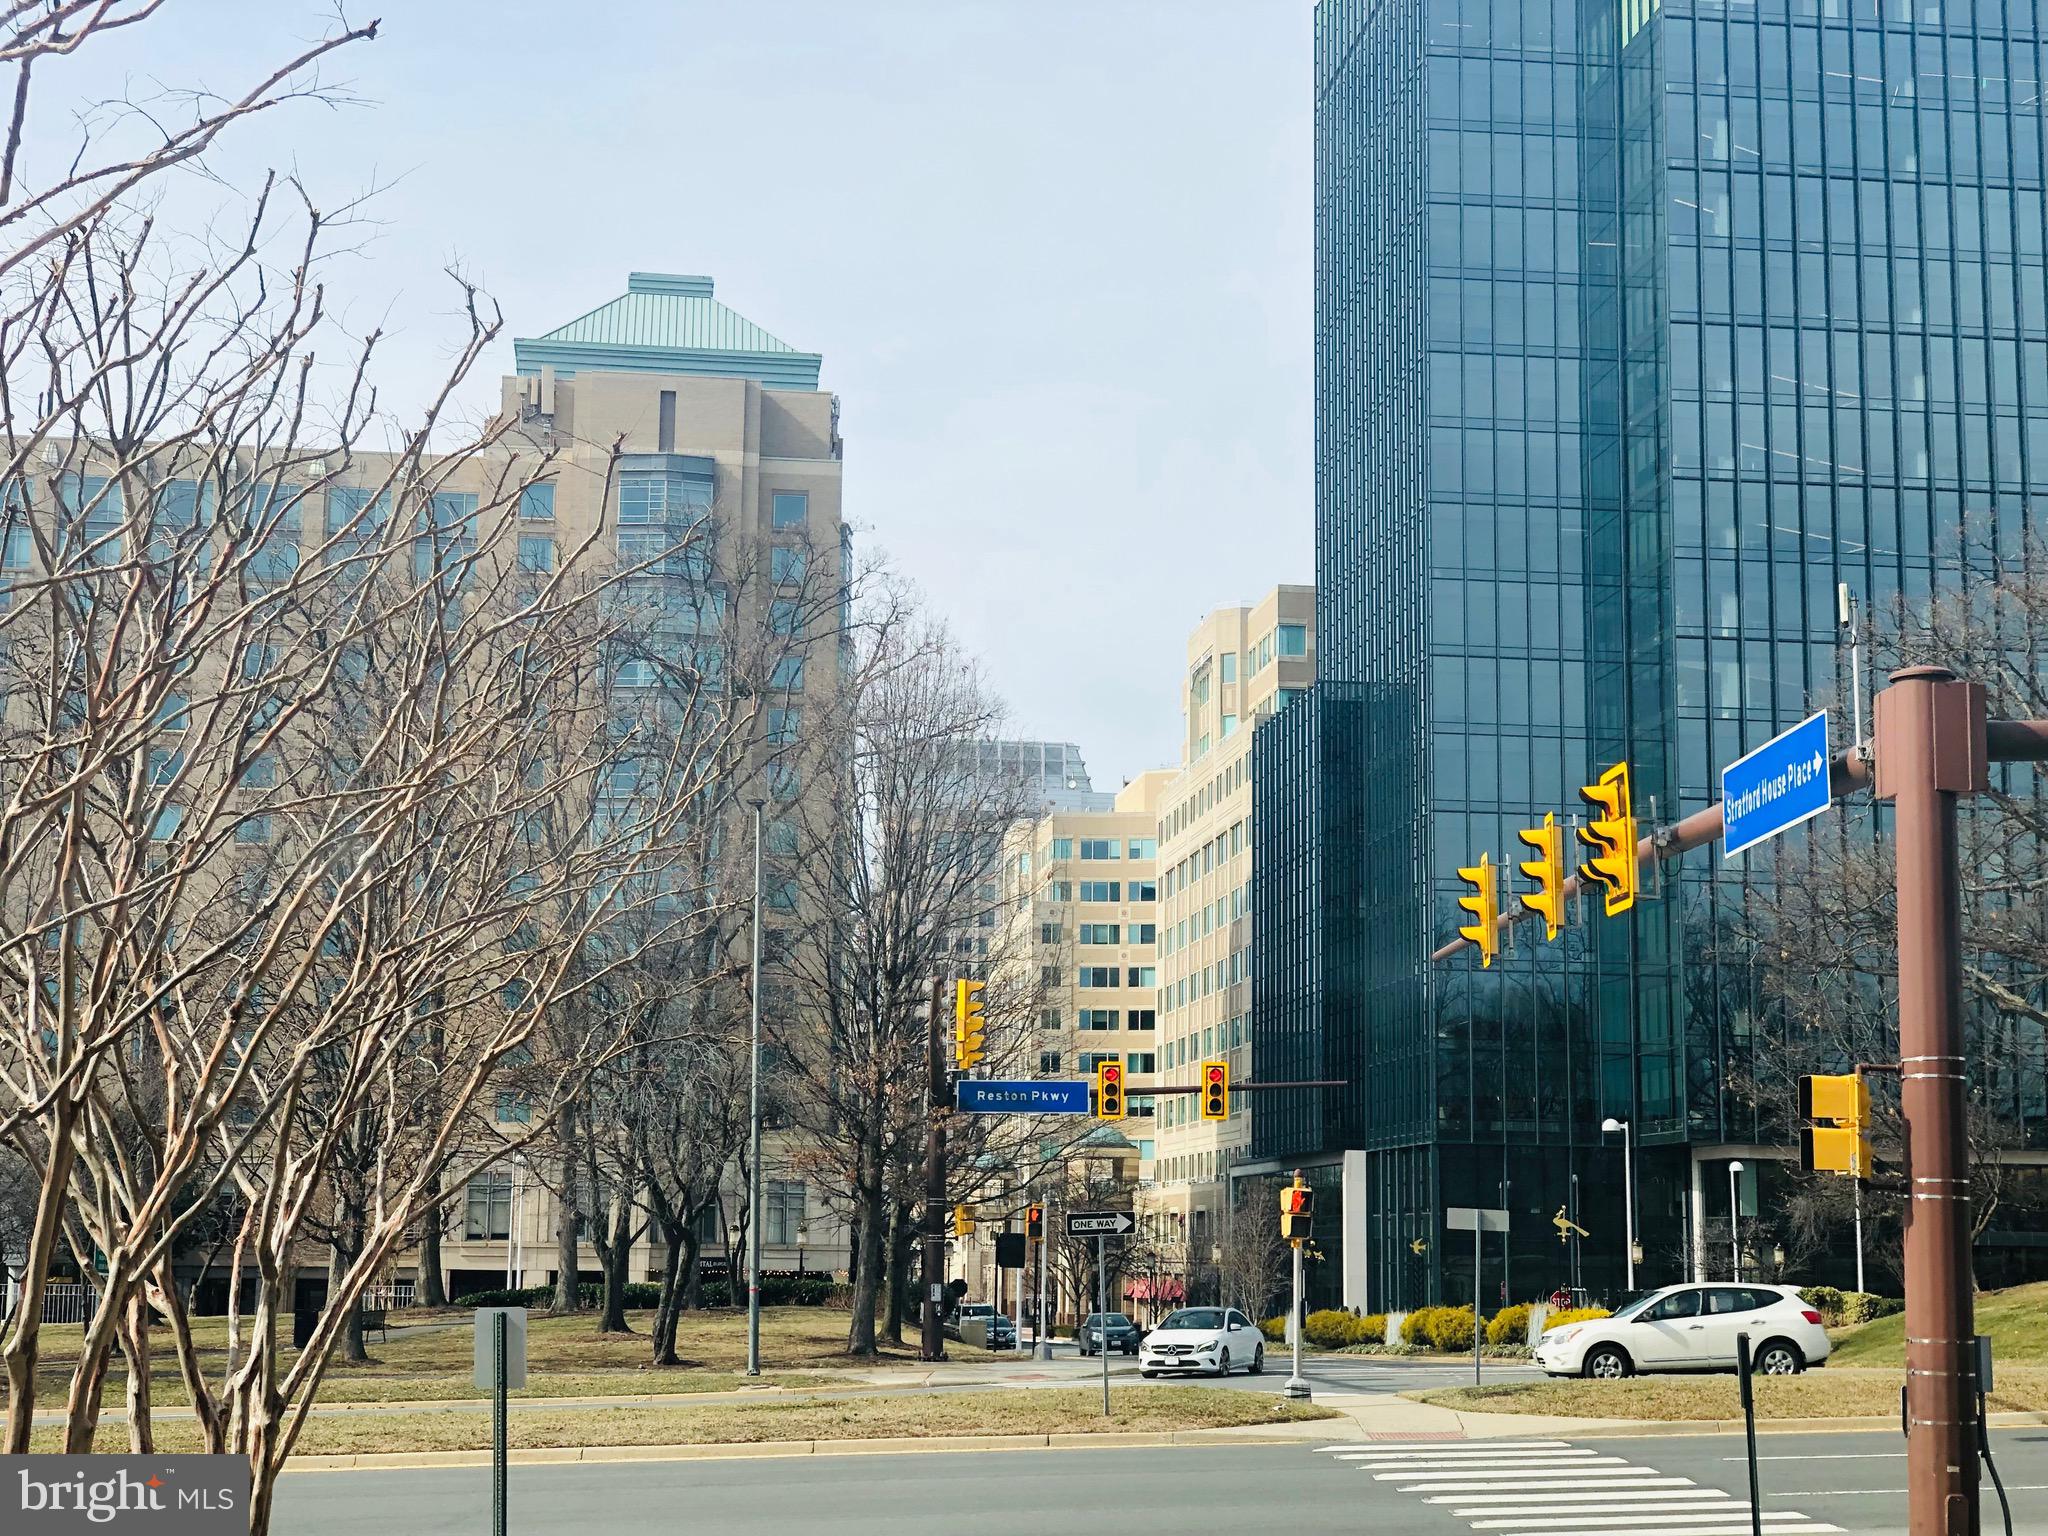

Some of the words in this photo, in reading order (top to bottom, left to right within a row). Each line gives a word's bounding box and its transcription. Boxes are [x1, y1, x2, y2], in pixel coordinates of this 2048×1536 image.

[1727, 782, 1761, 824] Stratford
[1762, 778, 1786, 805] House
[1788, 760, 1811, 791] Place
[977, 1090, 1027, 1101] Reston
[1031, 1090, 1069, 1103] Pkwy
[1073, 1220, 1093, 1229] ONE
[1096, 1219, 1116, 1228] WAY
